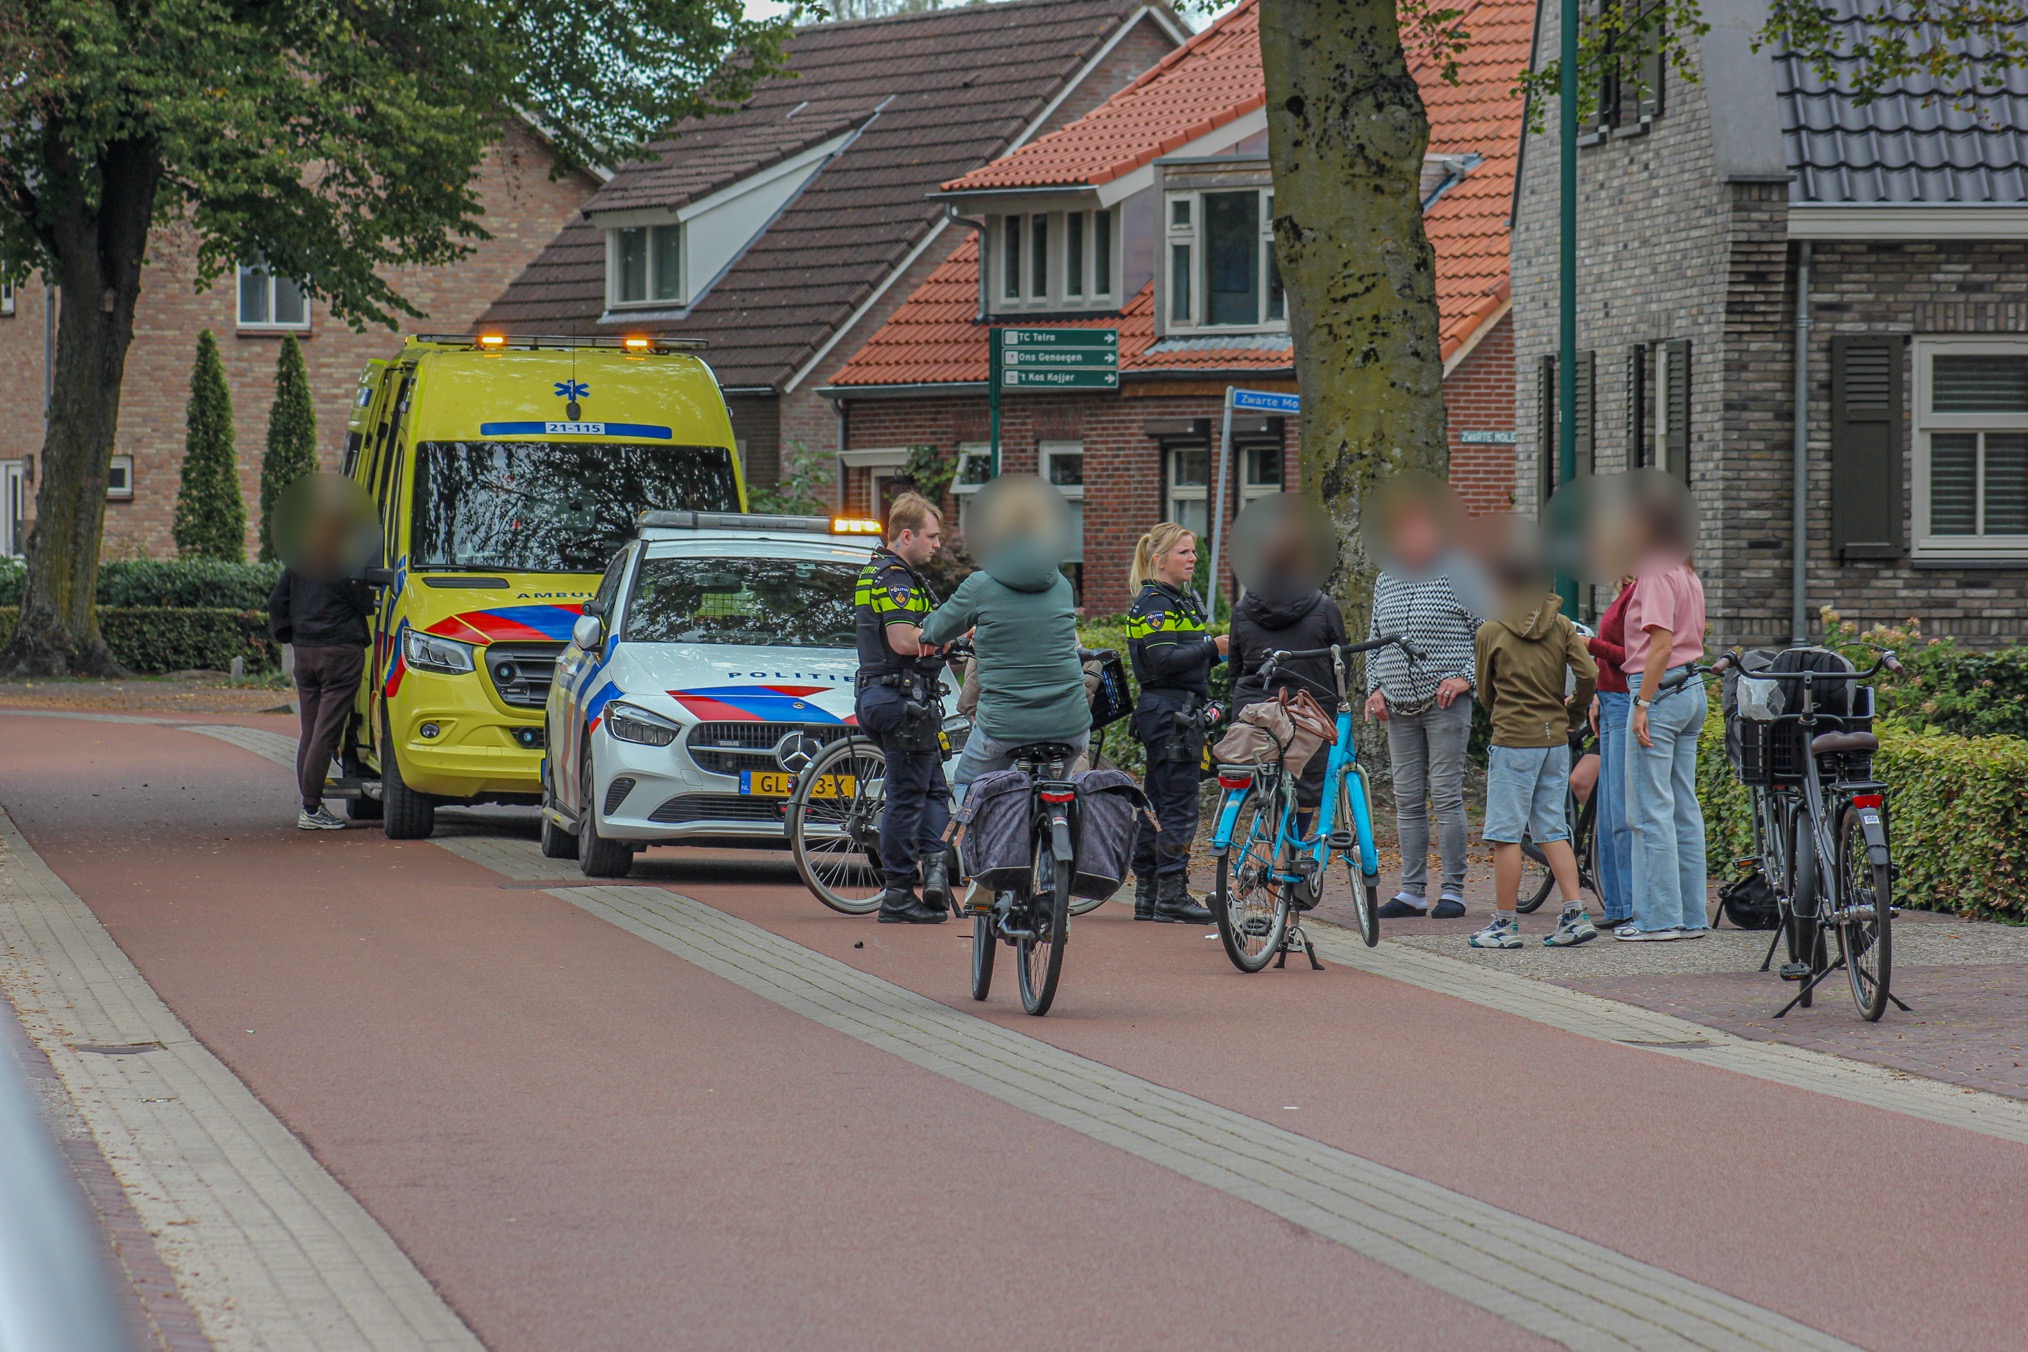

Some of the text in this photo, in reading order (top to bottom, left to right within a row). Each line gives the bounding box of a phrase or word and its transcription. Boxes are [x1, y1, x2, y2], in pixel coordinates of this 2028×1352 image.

[1018, 333, 1030, 341] TC
[1019, 353, 1082, 363] Ons Genoegen
[1241, 394, 1278, 407] Zwarte
[549, 423, 601, 433] 21-115
[728, 671, 856, 682] POLITIE
[761, 775, 846, 795] GL3-X
